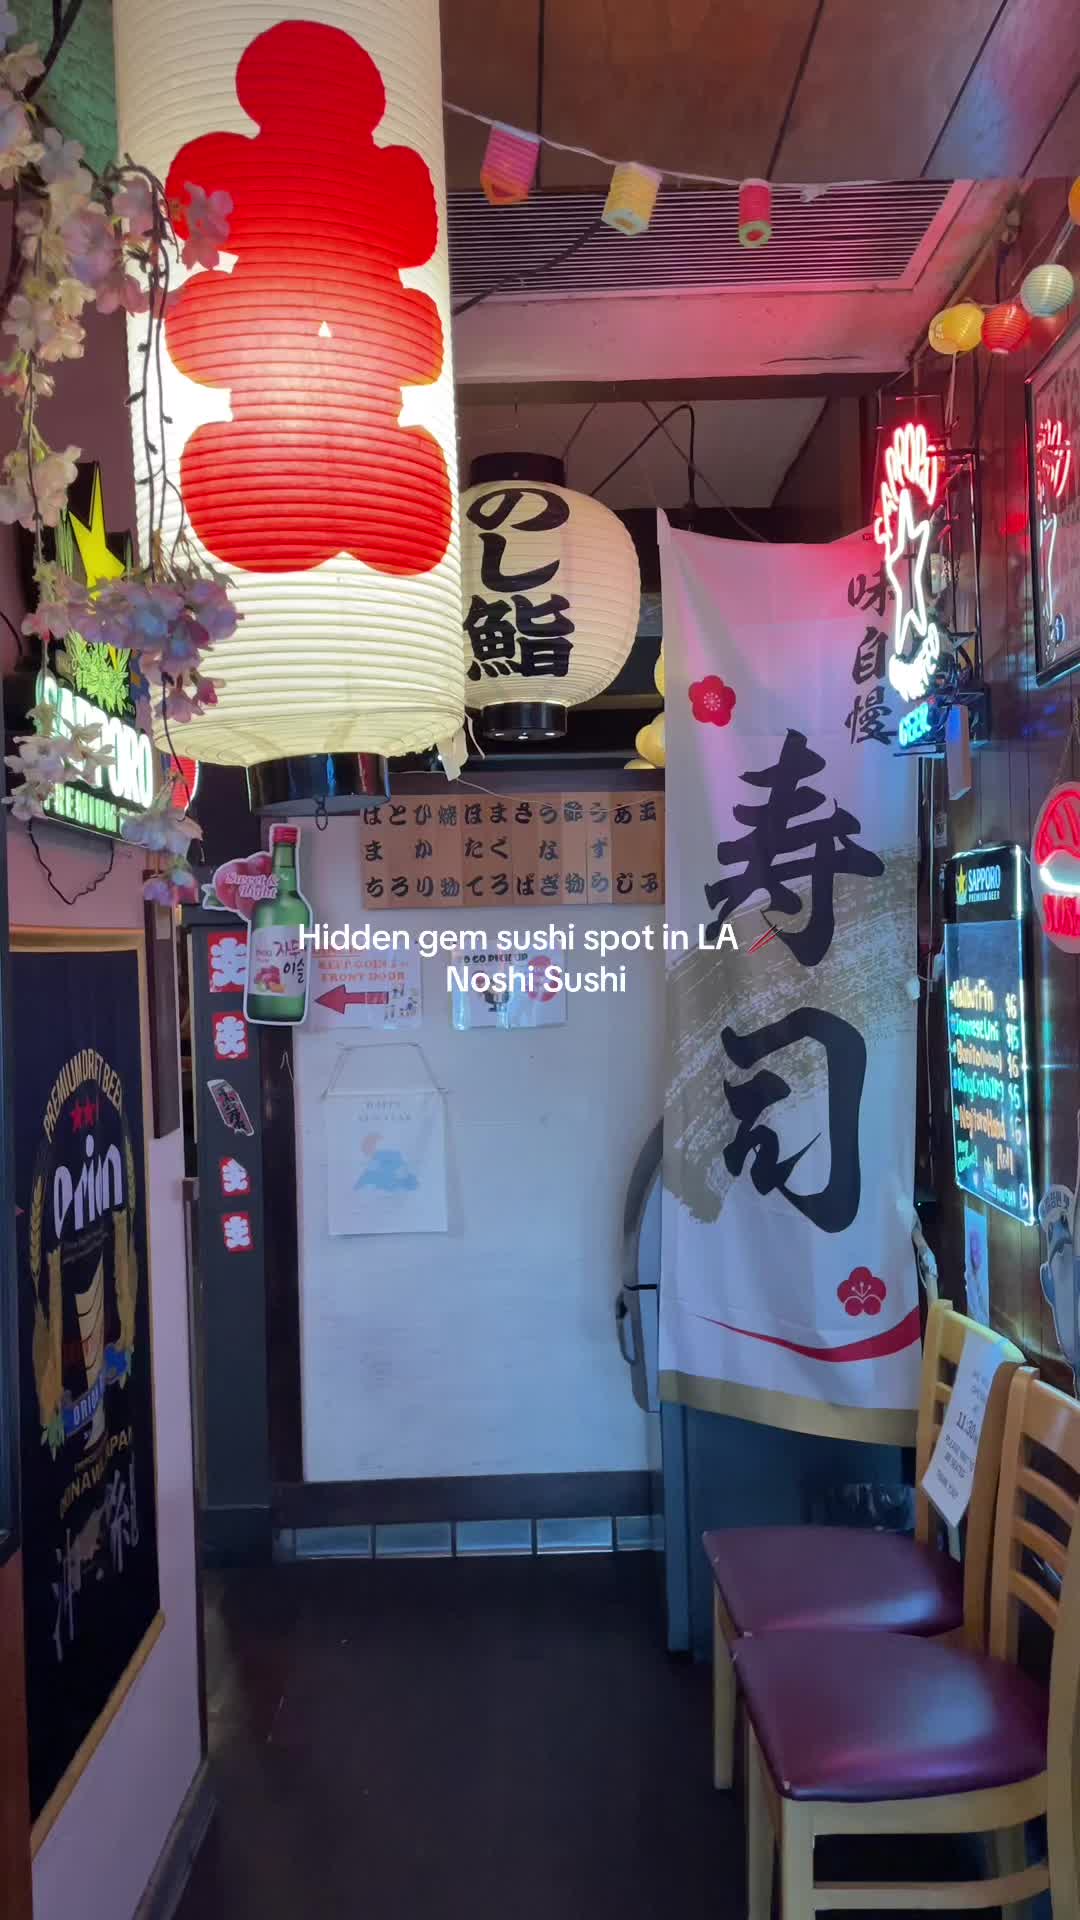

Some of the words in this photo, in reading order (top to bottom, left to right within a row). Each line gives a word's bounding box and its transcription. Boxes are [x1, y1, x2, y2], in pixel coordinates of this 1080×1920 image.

[463, 487, 575, 682] のし鮨
[844, 561, 898, 745] 味自慢
[363, 804, 384, 897] はまち
[388, 804, 409, 897] とろ
[464, 803, 484, 897] ほたて
[489, 802, 510, 896] まぐろ
[539, 802, 560, 897] うなぎ
[968, 864, 1001, 892] SAPPORO
[704, 728, 885, 1234] 寿司
